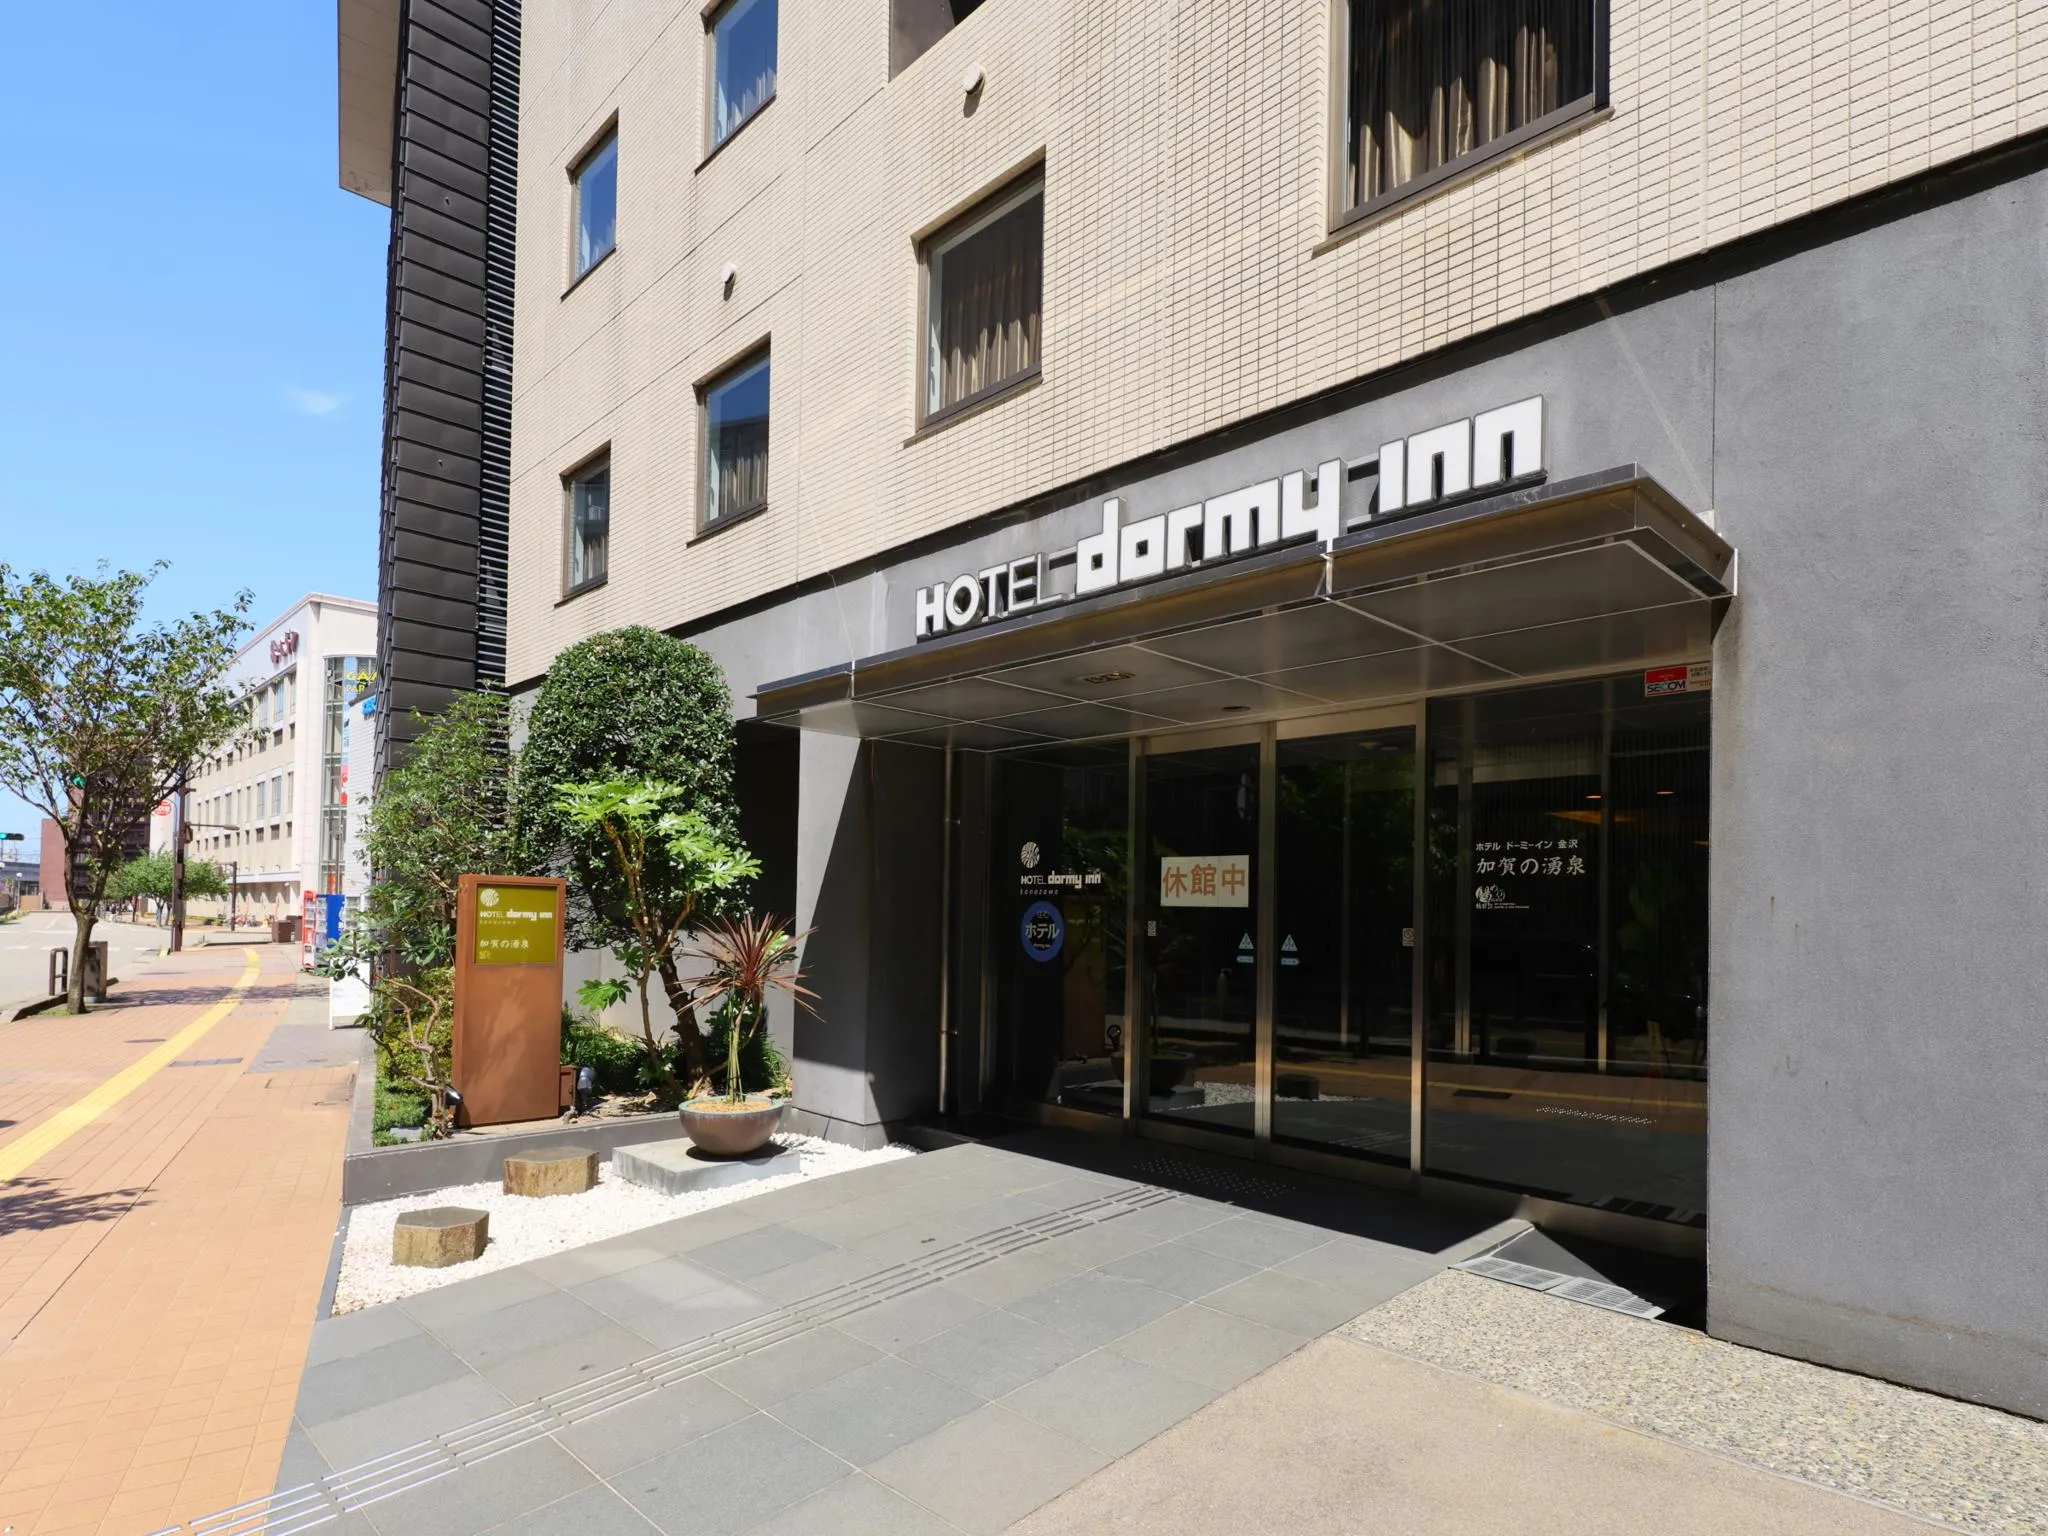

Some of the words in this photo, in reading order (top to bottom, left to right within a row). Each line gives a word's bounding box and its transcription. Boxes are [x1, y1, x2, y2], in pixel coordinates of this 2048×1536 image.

[916, 552, 1063, 637] HOTEL
[1076, 458, 1343, 596] dormy
[1378, 394, 1545, 515] inn
[1647, 680, 1686, 692] SECOM
[1475, 842, 1501, 851] ホテル
[1506, 840, 1553, 850] ドーミーイン
[1557, 839, 1579, 849] 金沢
[1475, 855, 1585, 876] 加賀の湧泉
[1020, 875, 1047, 885] HOTEL
[1047, 869, 1082, 889] dormy
[1084, 872, 1102, 885] inn
[1162, 863, 1246, 898] 休館中
[506, 908, 537, 921] dormy
[539, 911, 553, 919] inn
[1024, 922, 1060, 940] ホテル
